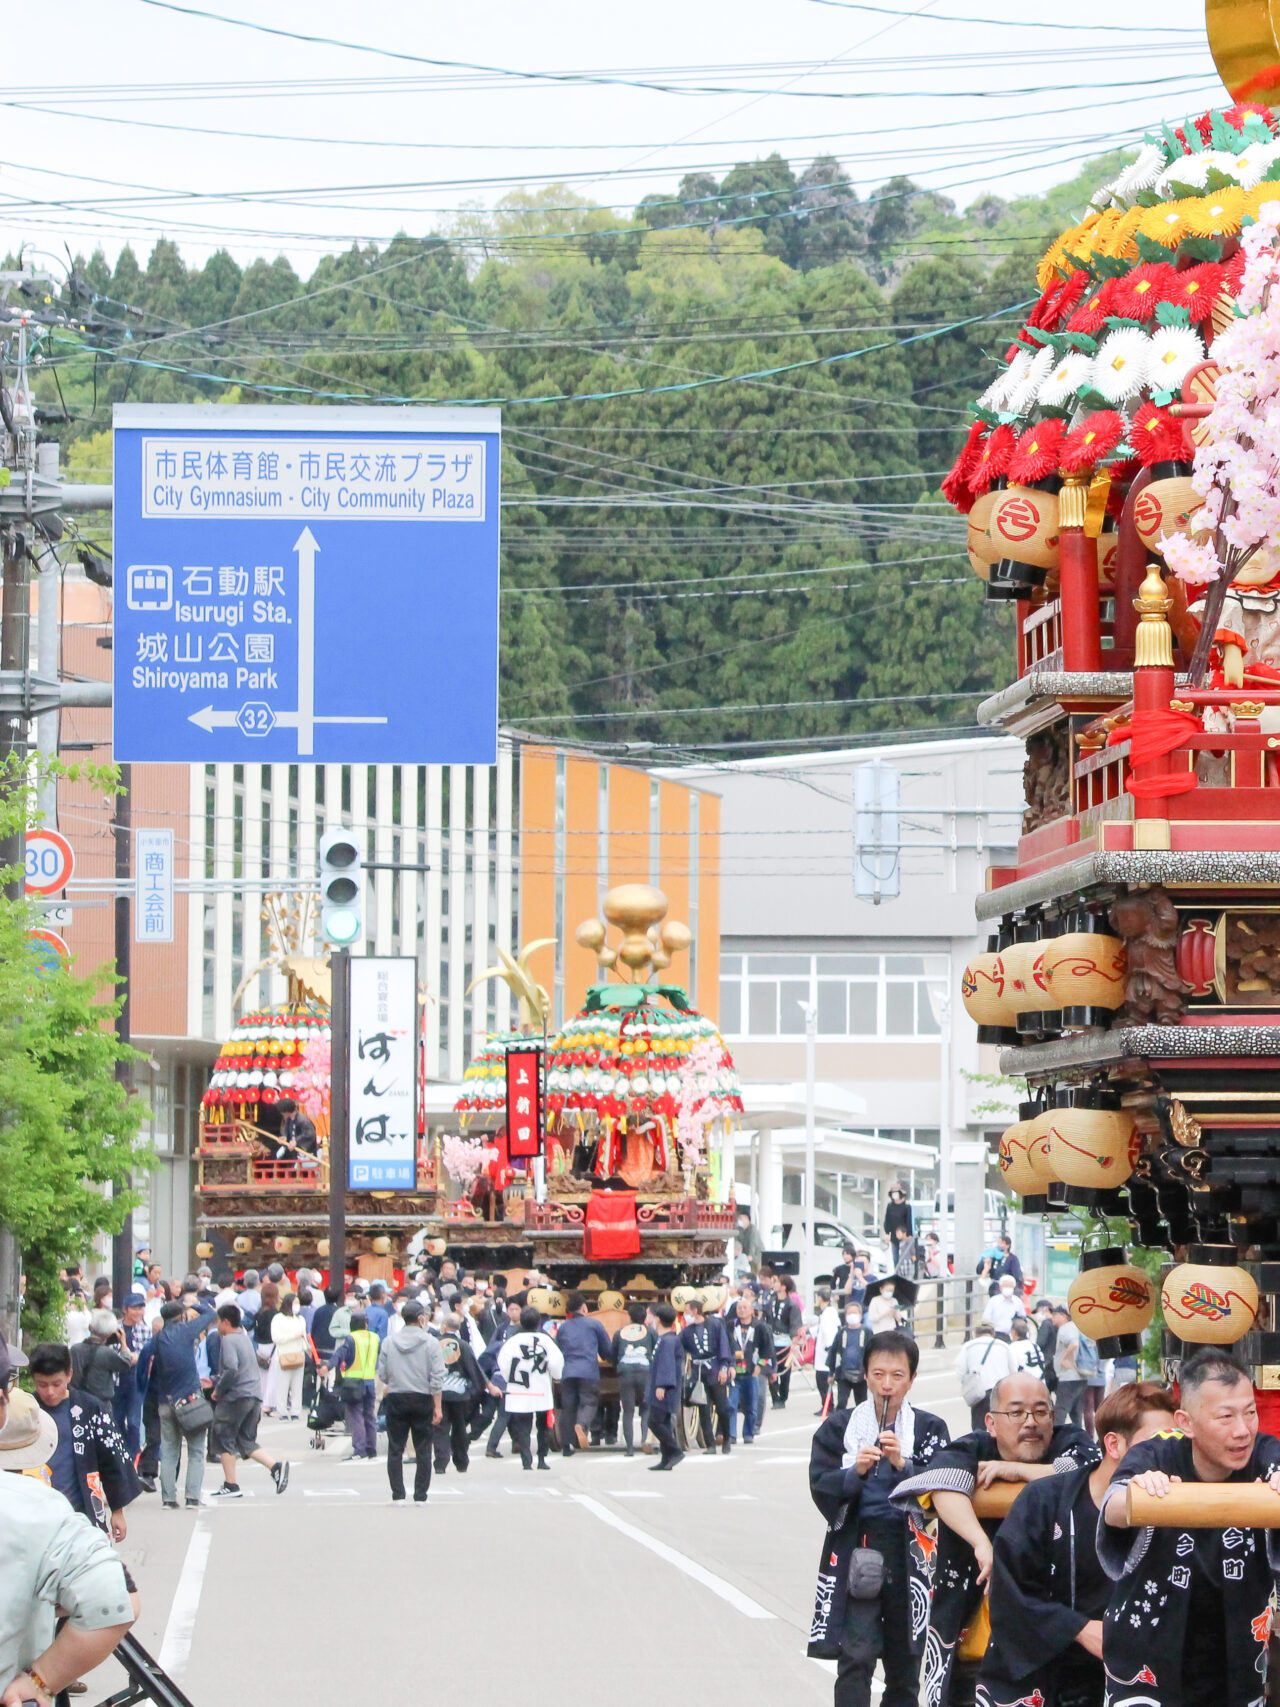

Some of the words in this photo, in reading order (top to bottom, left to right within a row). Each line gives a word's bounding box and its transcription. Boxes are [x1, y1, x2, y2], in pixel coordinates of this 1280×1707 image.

[154, 449, 474, 483] 市民体育館・市民交流プラザ
[153, 485, 183, 510] City
[190, 486, 283, 511] Gymnasium
[301, 486, 330, 511] City
[338, 487, 426, 513] Community
[432, 488, 474, 509] Plaza
[182, 566, 286, 597] 石動駅
[175, 600, 244, 627] Isurugi
[252, 600, 292, 625] Sta.
[136, 632, 275, 663] 城山公園
[132, 665, 229, 693] Shiroyama
[236, 667, 279, 689] Park
[244, 709, 269, 729] 32
[25, 848, 59, 877] 30
[144, 851, 165, 934] 商工会前
[371, 1167, 410, 1181] 駐車場
[1170, 1533, 1195, 1590] 今町
[1221, 1527, 1245, 1580] 今町
